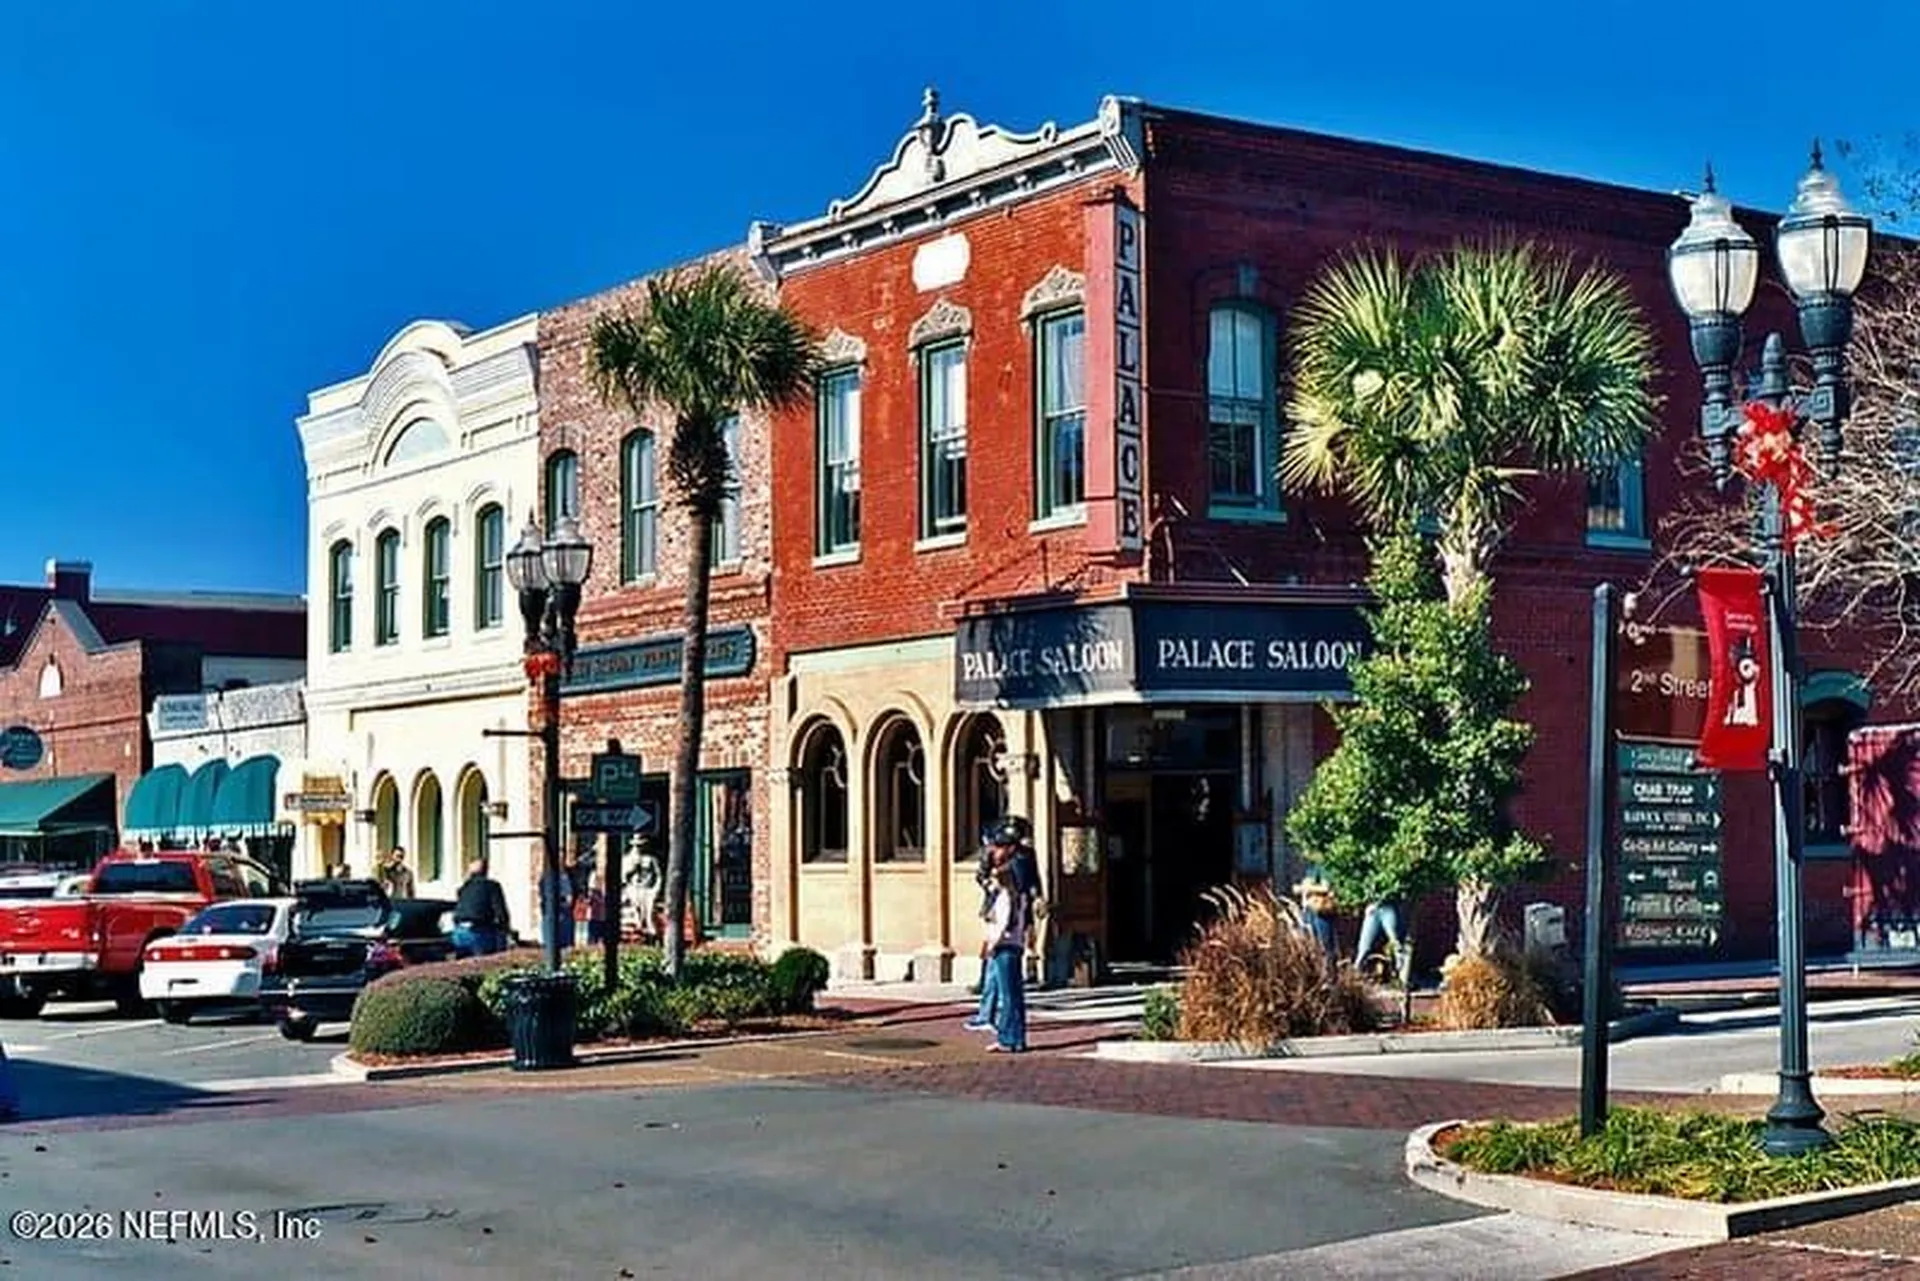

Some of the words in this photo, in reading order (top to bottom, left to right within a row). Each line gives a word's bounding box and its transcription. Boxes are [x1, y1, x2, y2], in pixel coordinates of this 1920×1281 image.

[1118, 220, 1137, 539] PALACE
[963, 647, 1033, 682] PALACE
[1039, 638, 1124, 677] SALOON
[1158, 639, 1256, 668] PALACE
[1266, 641, 1363, 670] SALOON
